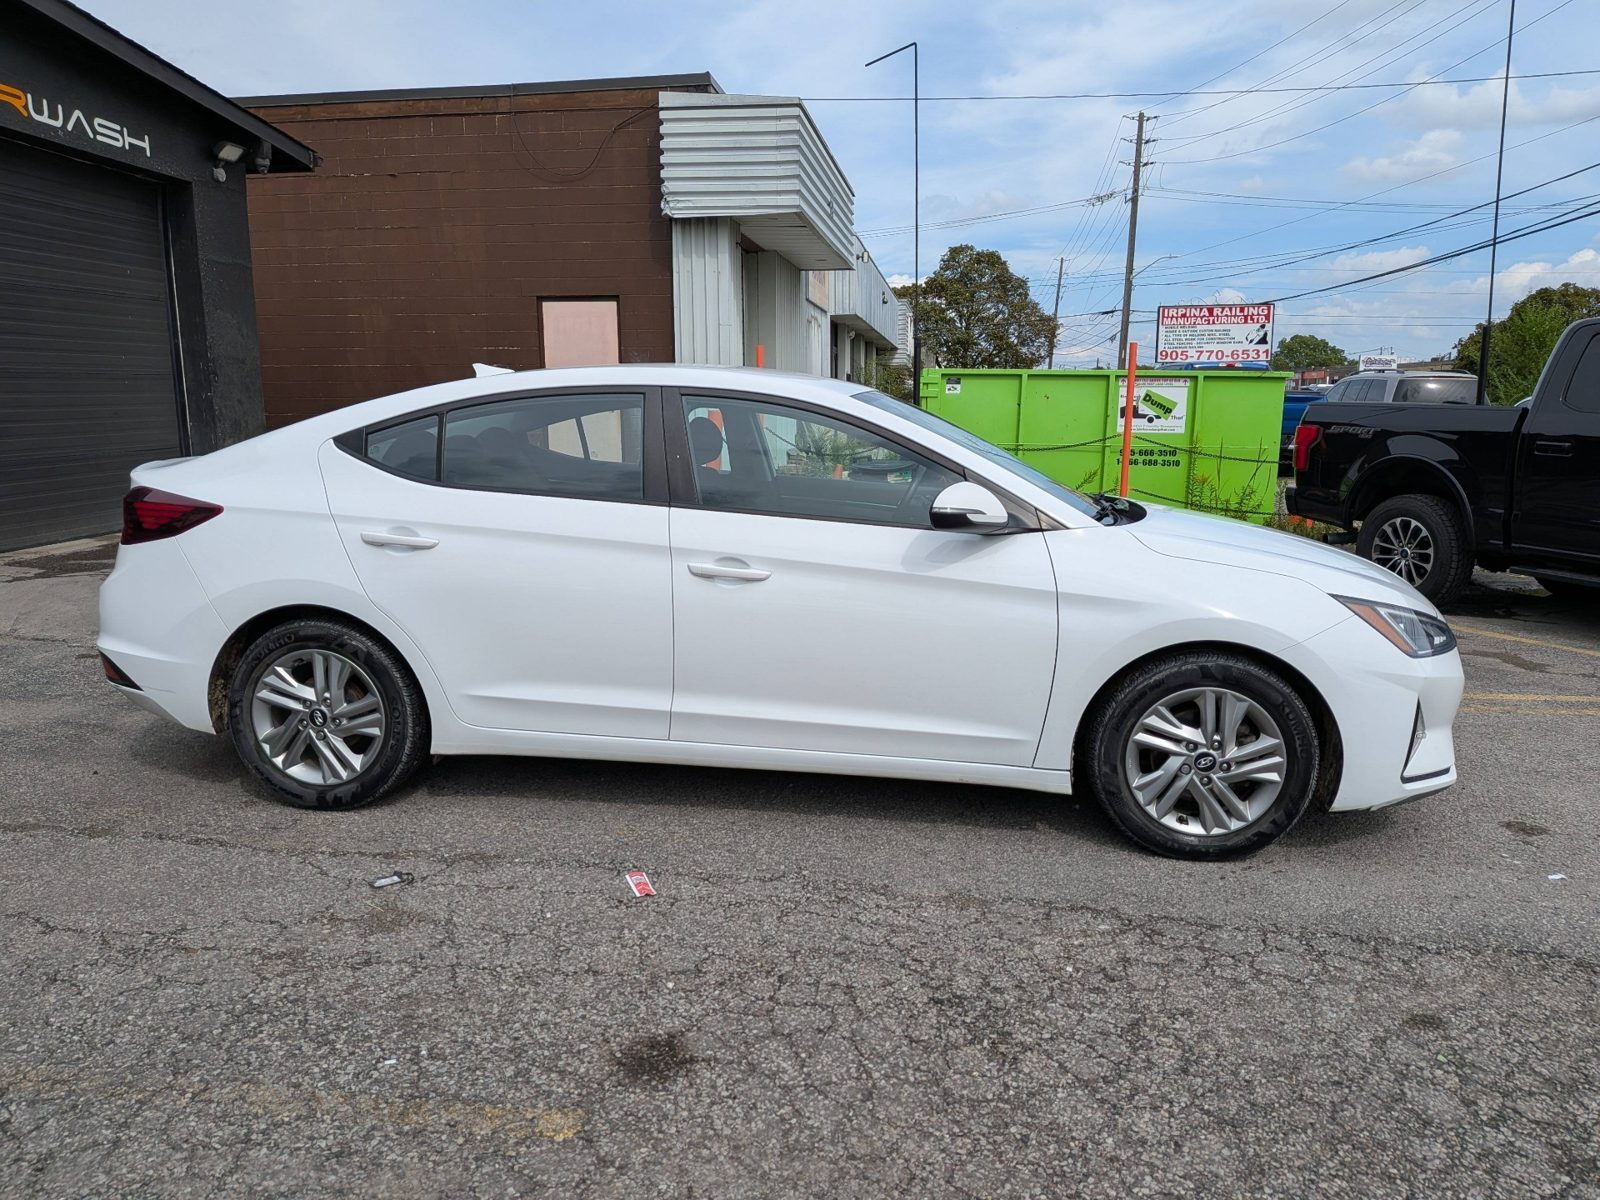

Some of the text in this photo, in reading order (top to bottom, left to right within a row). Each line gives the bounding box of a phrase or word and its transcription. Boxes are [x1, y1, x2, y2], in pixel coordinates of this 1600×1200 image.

[1164, 306, 1268, 317] IRPINA RAILING
[1163, 315, 1269, 325] MANUFACTURING LTD.
[1160, 349, 1270, 360] 905-770-6531
[1142, 393, 1173, 415] Dump
[1120, 449, 1177, 457] 95-666-3510
[1116, 458, 1180, 467] 1-66-688-3510
